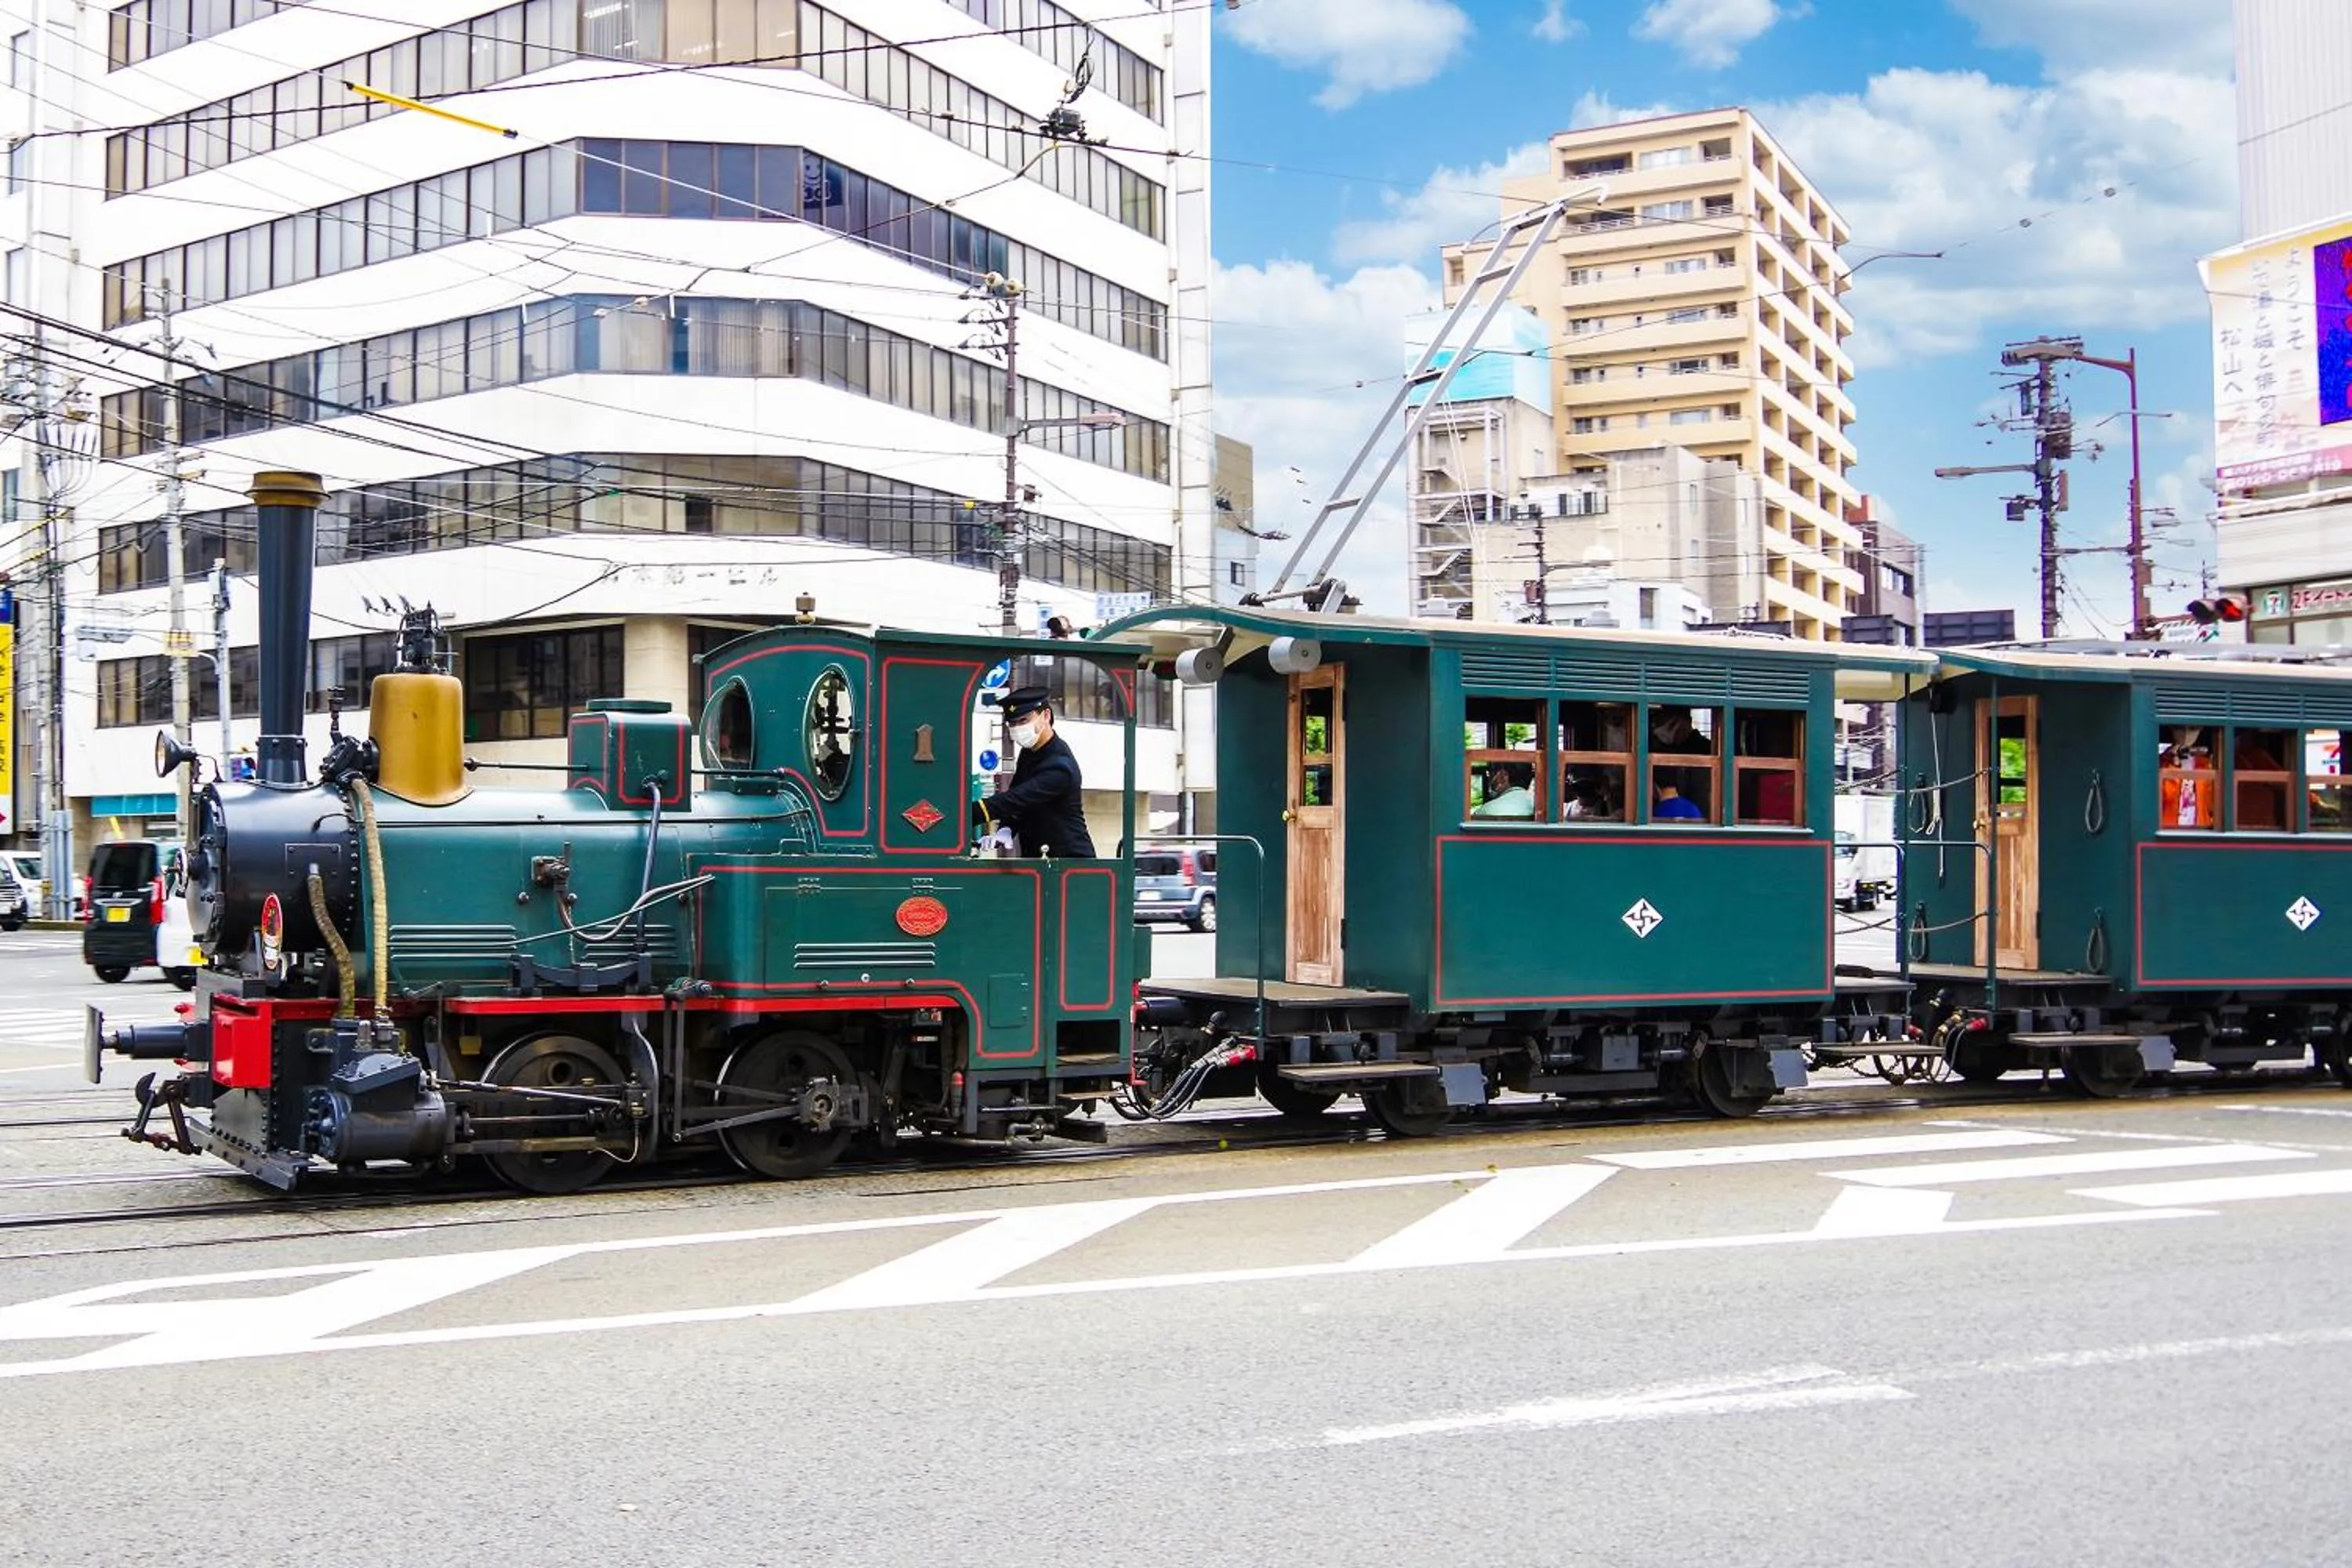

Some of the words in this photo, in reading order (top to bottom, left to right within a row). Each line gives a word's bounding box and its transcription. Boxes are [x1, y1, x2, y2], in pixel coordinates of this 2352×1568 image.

[2285, 249, 2306, 350] ようこそ
[2220, 327, 2243, 392] 松山へ
[913, 723, 935, 761] 1
